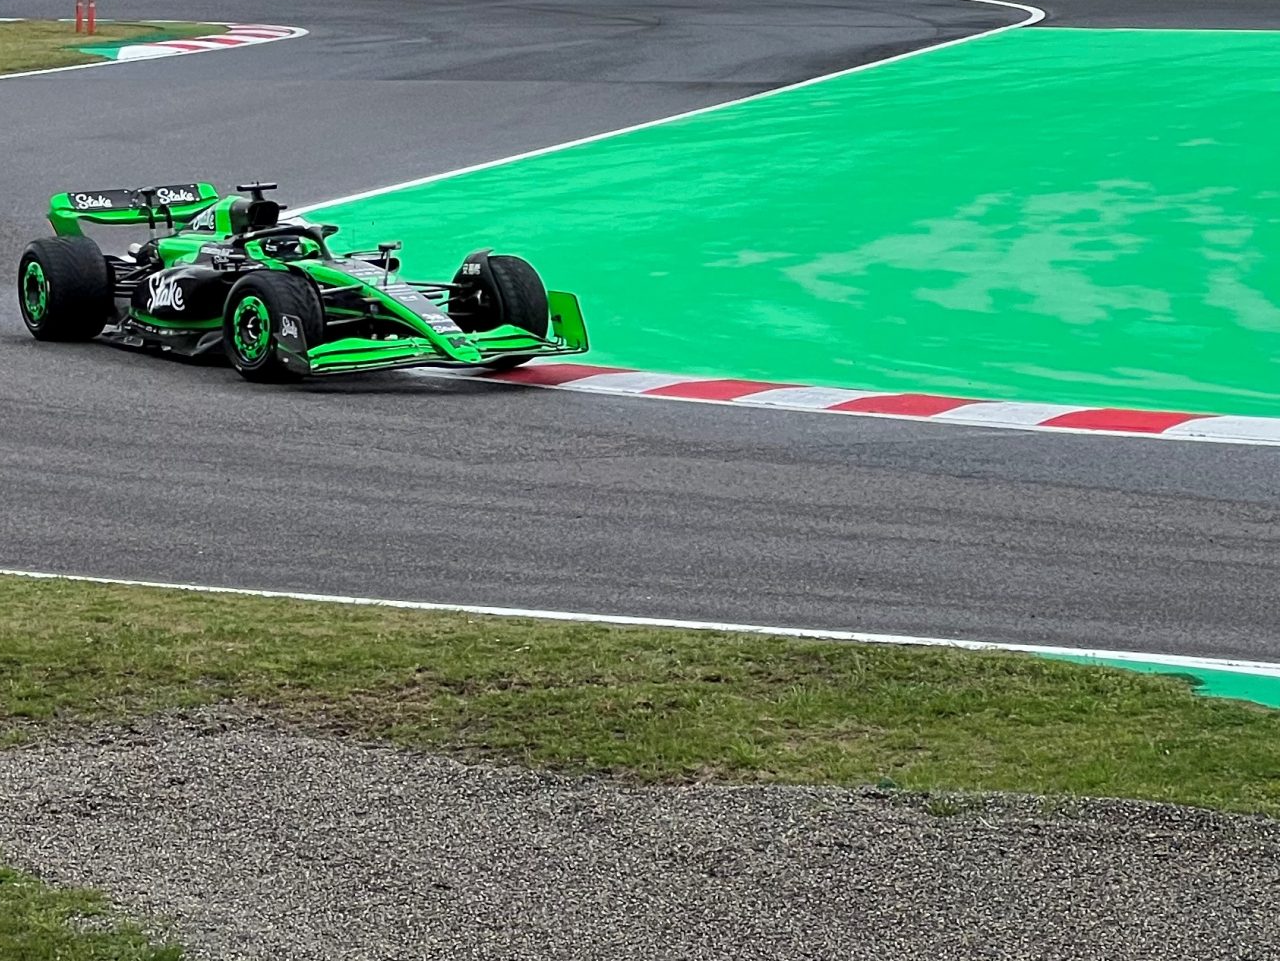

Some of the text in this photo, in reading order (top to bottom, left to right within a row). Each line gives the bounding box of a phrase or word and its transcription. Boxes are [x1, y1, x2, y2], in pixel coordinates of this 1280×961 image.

[75, 193, 113, 210] Stake
[157, 187, 195, 205] Stake
[146, 271, 186, 314] Stake
